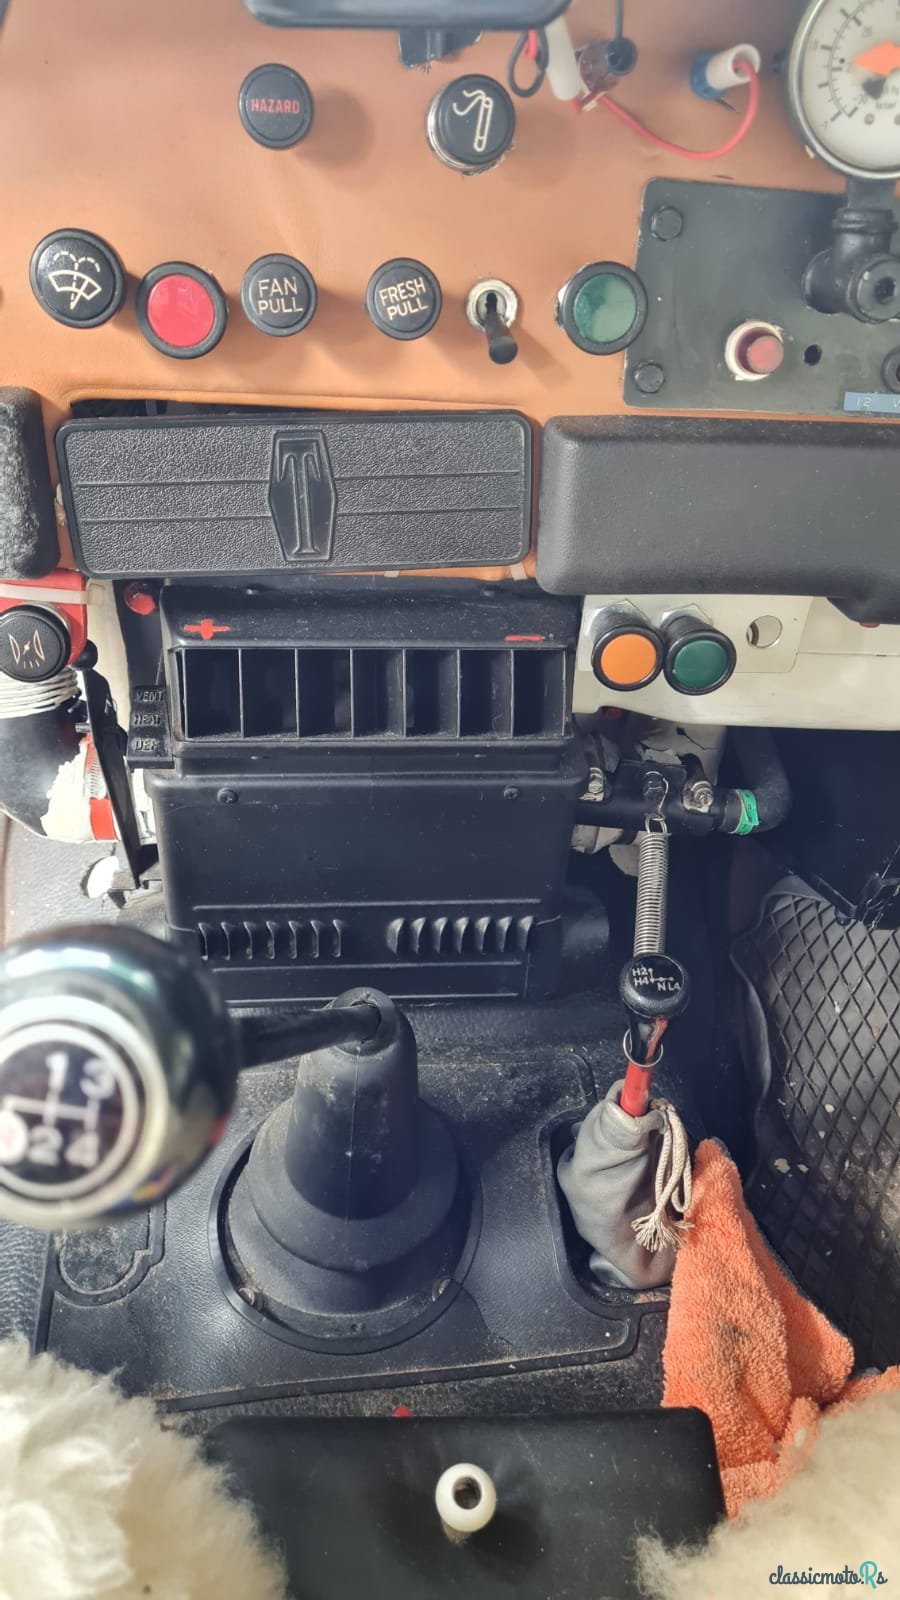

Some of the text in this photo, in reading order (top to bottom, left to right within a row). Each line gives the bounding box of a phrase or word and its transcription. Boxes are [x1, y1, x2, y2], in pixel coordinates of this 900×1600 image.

[250, 98, 300, 114] HAZARD
[258, 276, 298, 298] FAN
[379, 276, 426, 307] FRESH
[257, 297, 303, 316] PULL
[386, 298, 428, 320] PULL
[856, 396, 872, 408] 12
[136, 690, 166, 703] VENT
[134, 713, 161, 727] HEAT
[632, 967, 648, 977] H2
[634, 976, 650, 987] H4
[657, 982, 667, 991] N
[46, 1053, 116, 1100] 1 3
[28, 1125, 99, 1168] 2 4
